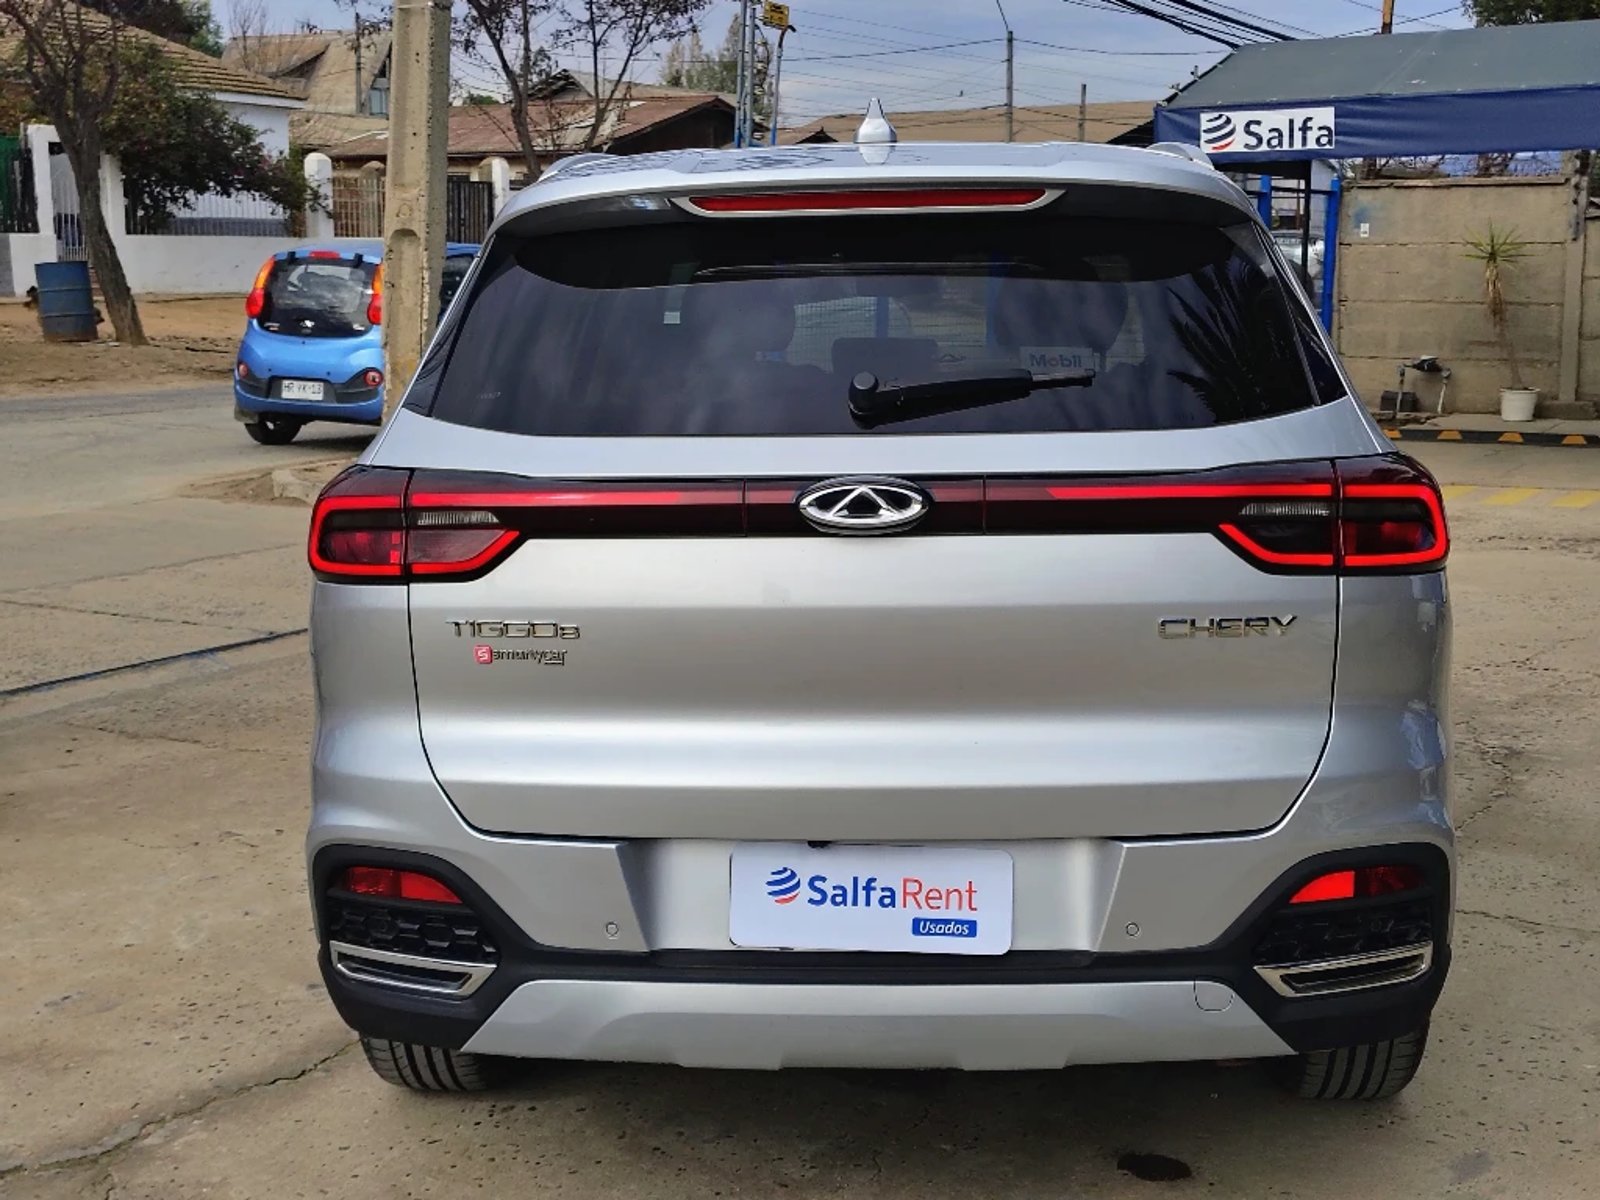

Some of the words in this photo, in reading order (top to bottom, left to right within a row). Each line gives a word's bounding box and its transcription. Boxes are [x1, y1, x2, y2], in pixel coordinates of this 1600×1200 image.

[1243, 116, 1334, 150] Salfa
[1030, 352, 1082, 369] Mobil
[1158, 614, 1297, 640] CHERY
[807, 875, 979, 911] SalfaRent
[919, 920, 970, 936] Usados
